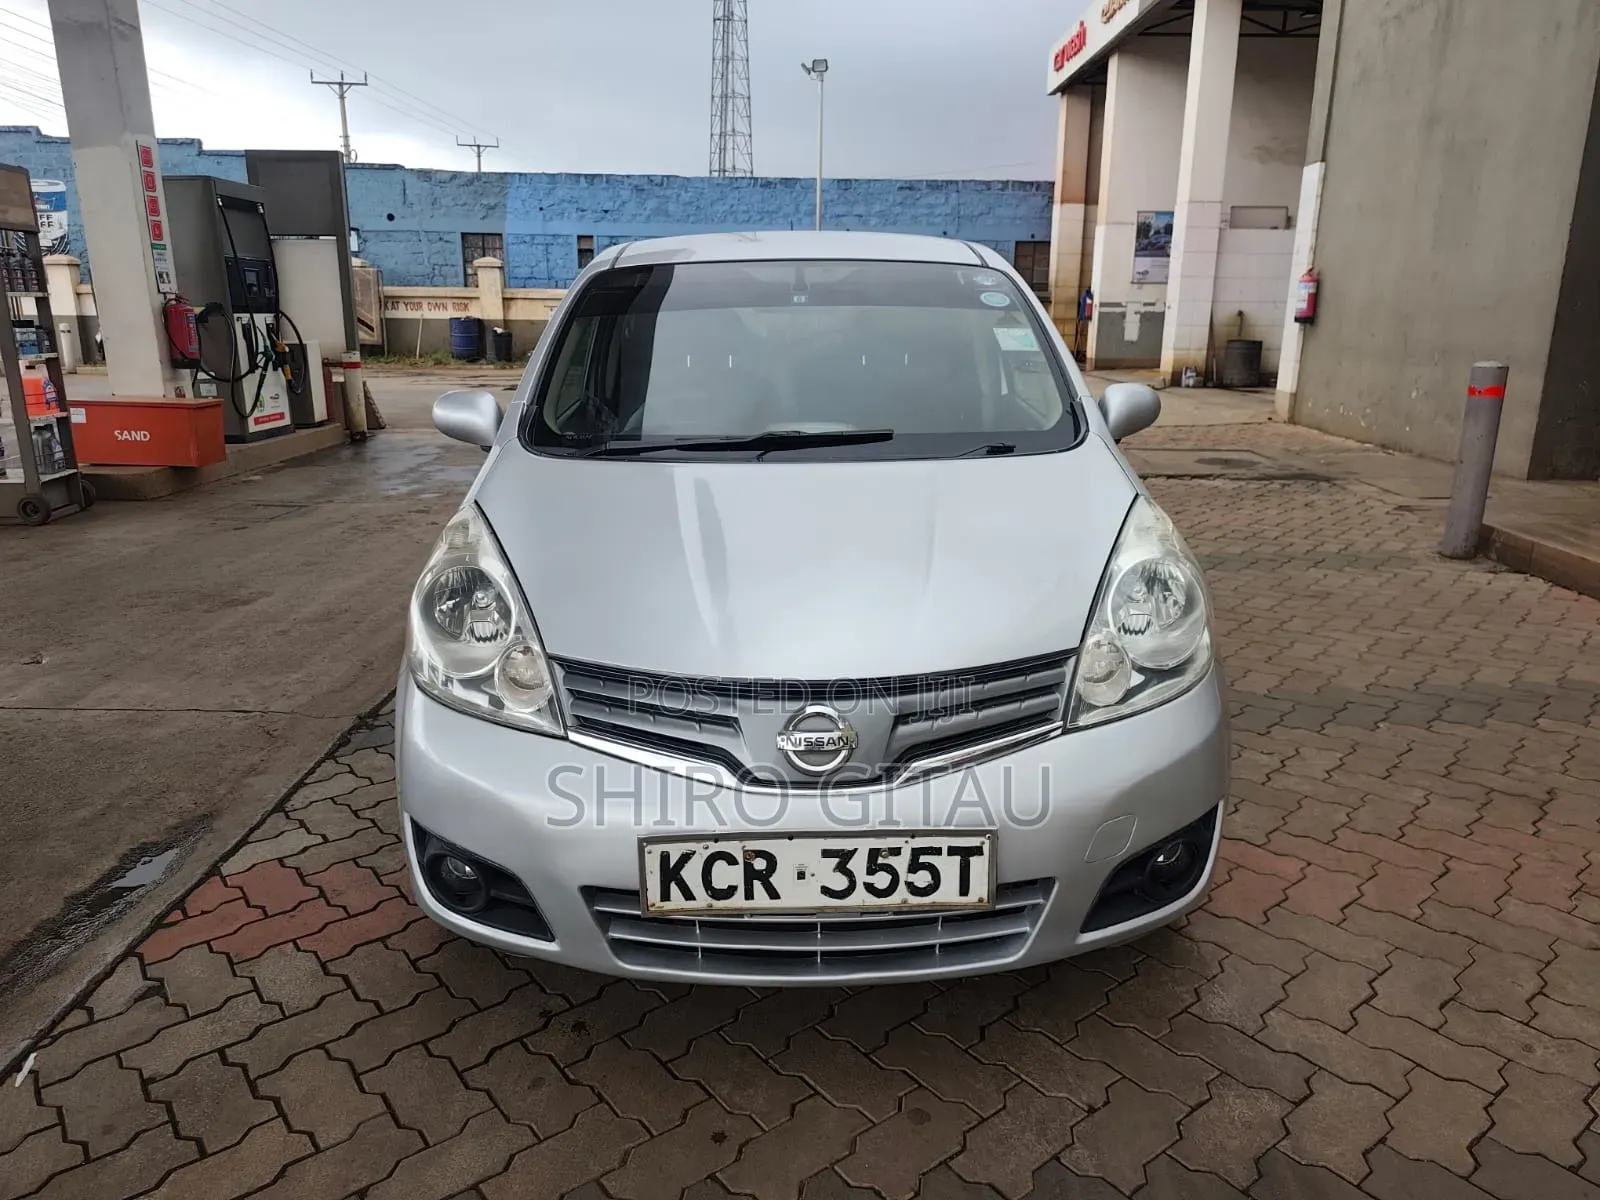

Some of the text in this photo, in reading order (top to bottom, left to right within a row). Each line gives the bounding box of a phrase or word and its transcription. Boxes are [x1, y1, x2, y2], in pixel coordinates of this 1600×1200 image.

[391, 301, 400, 312] AT
[403, 301, 423, 312] YOUR
[427, 301, 448, 312] OWN
[452, 302, 470, 312] RISK
[114, 430, 151, 442] SAND
[786, 736, 849, 748] NISSAN
[659, 845, 985, 902] KCR 355T
